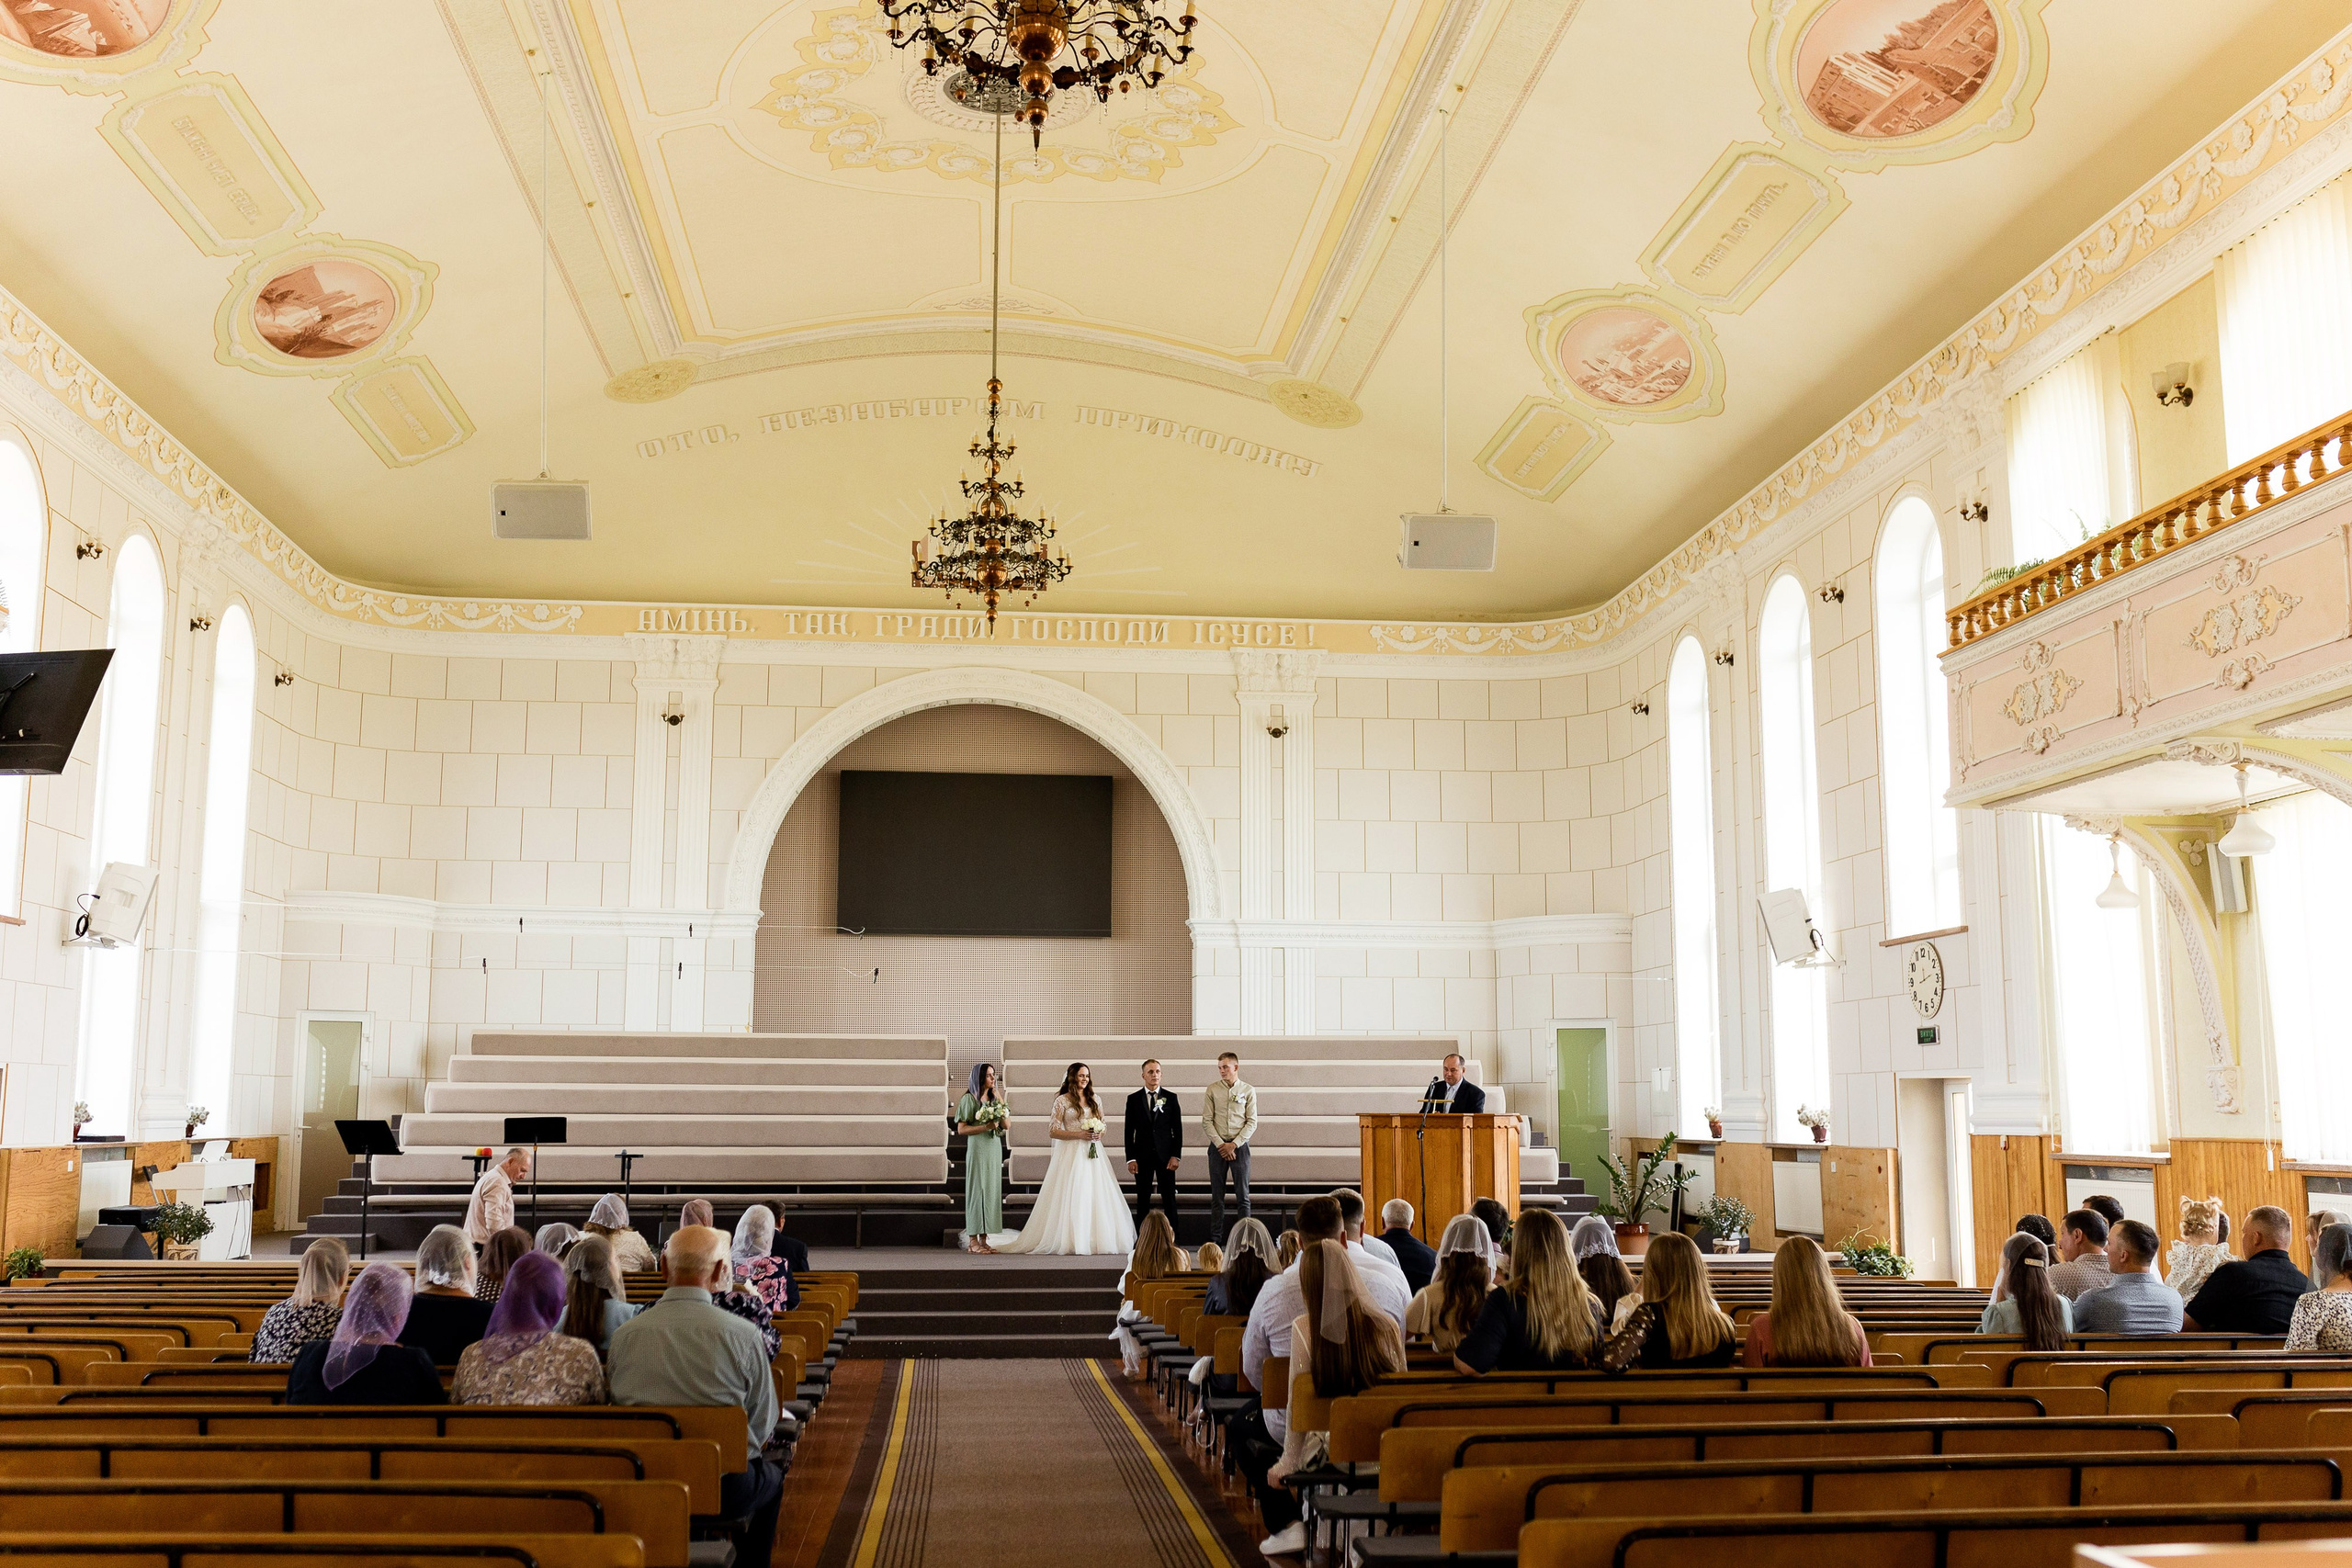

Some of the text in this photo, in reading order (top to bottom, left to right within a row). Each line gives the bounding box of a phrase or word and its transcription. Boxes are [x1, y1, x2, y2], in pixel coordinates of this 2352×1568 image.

[637, 397, 1323, 479] ОТО, НЕЗАБАРОМ ПРИХОДЖУ
[637, 609, 756, 633] АМІНЬ.
[783, 613, 857, 637] ТАК,
[1011, 618, 1170, 646] ГОСПОДИ
